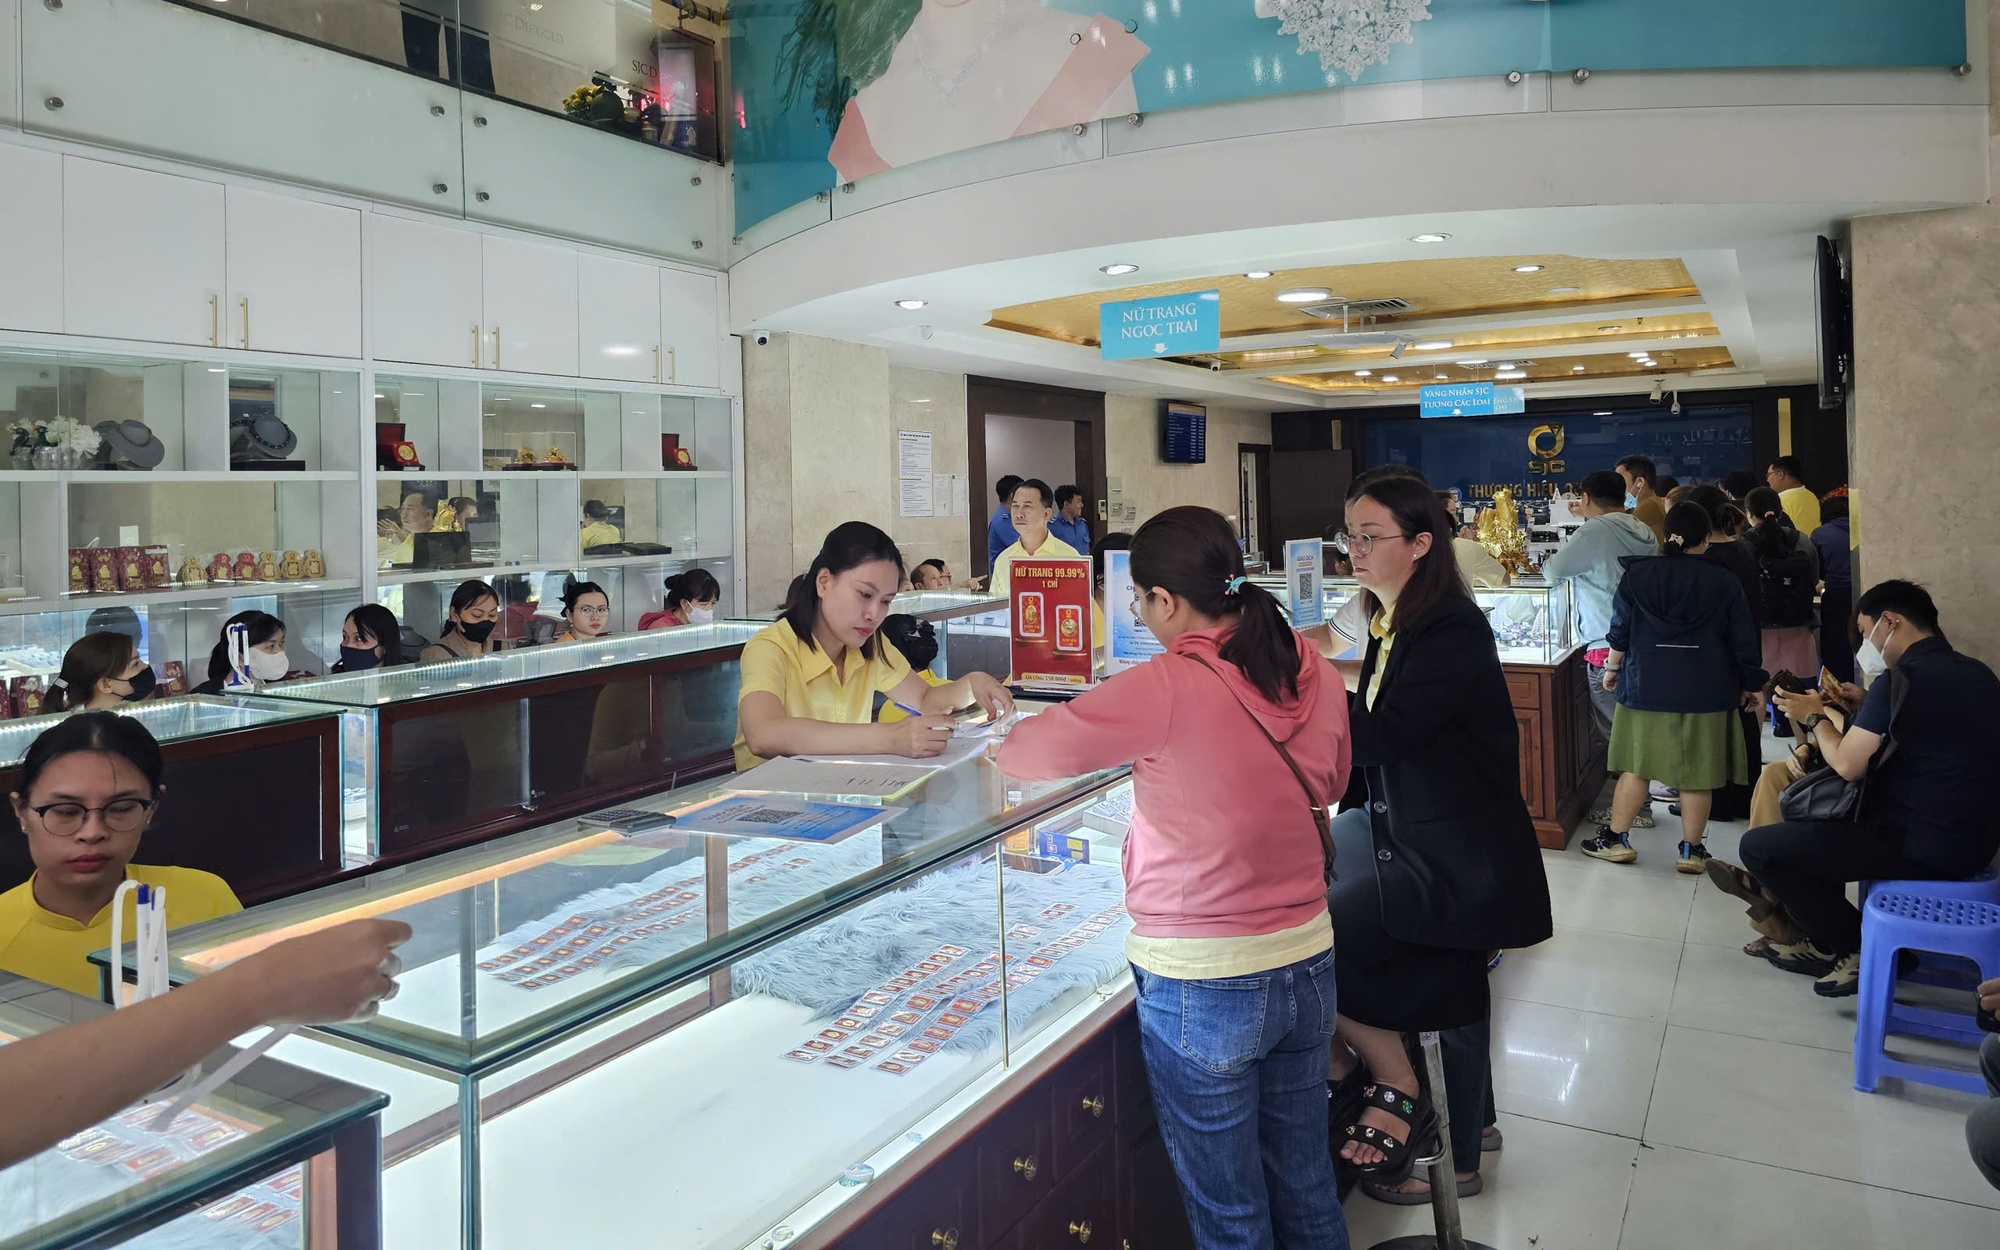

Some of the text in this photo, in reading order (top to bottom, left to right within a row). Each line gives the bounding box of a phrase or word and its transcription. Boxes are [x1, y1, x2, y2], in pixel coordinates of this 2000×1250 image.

[1123, 303, 1196, 323] NỮ TRANG
[1121, 319, 1198, 340] NGỌC TRAI
[1015, 566, 1086, 578] NỮ TRANG 99.99%
[1042, 580, 1046, 588] 1
